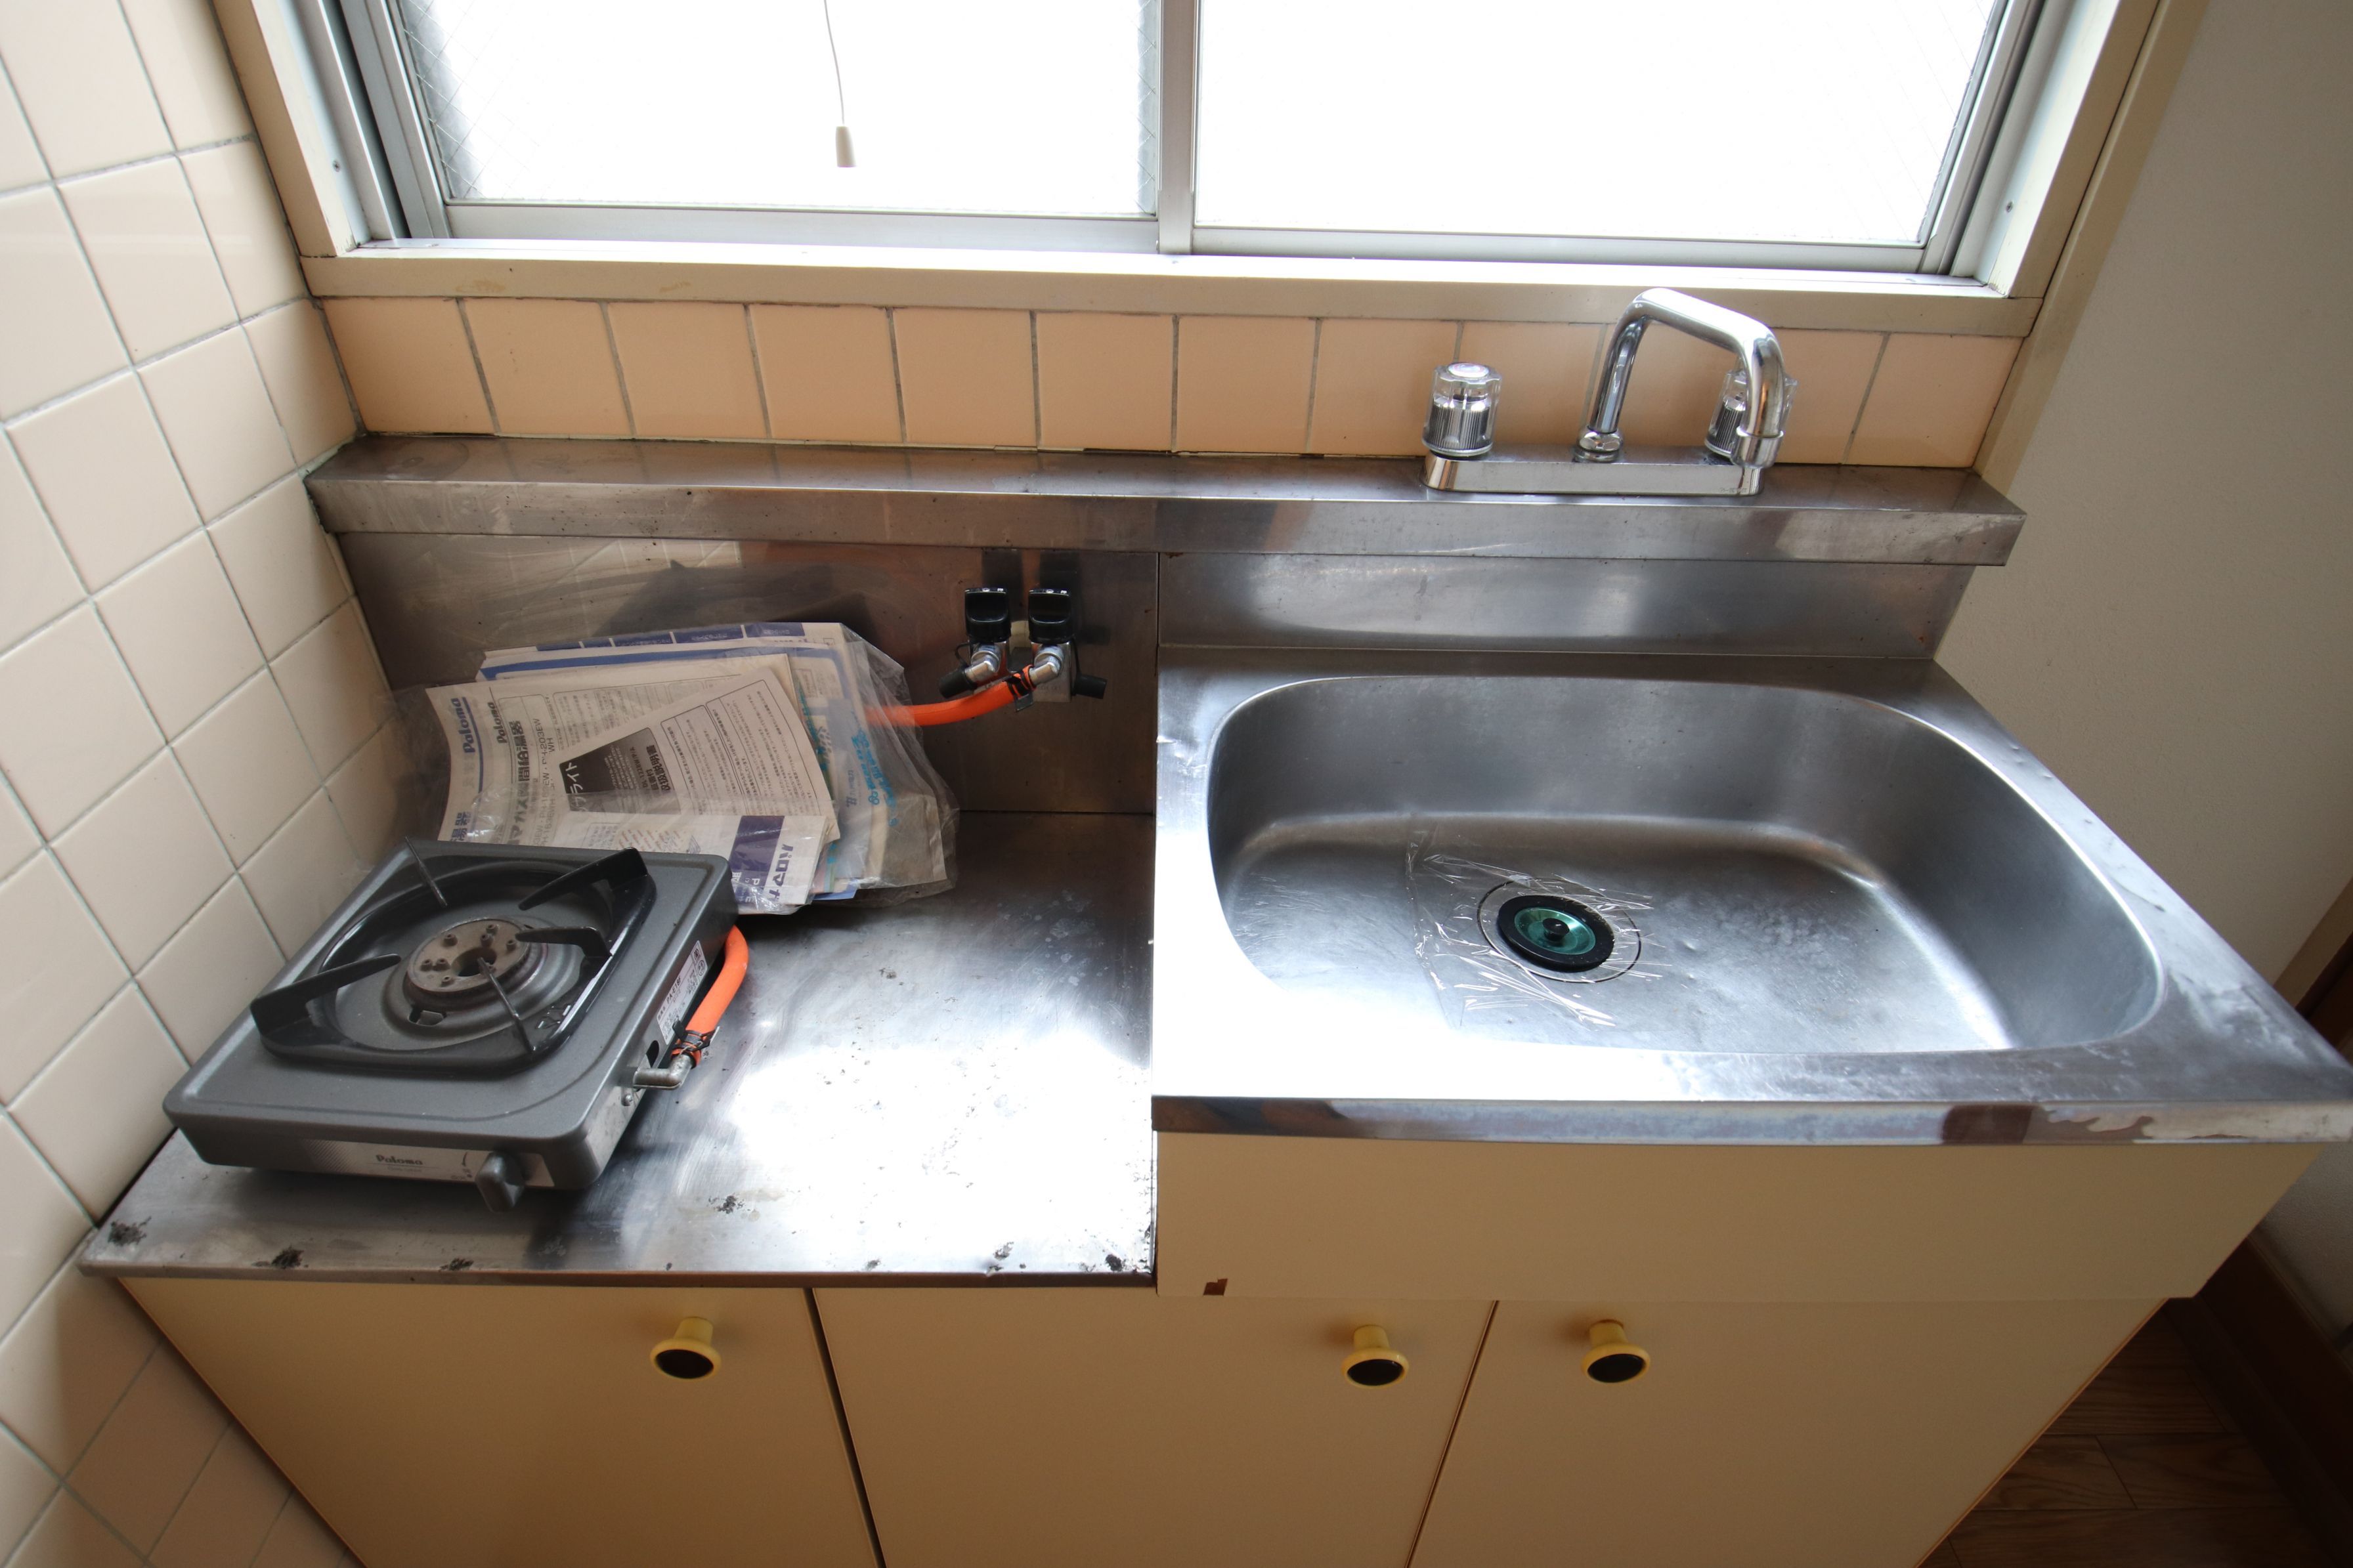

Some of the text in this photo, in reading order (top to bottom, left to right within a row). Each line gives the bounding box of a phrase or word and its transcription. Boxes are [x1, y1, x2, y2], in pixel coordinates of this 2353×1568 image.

[450, 697, 475, 753] Paloma
[486, 702, 507, 744] Paloma
[376, 1154, 423, 1165] Paloma
